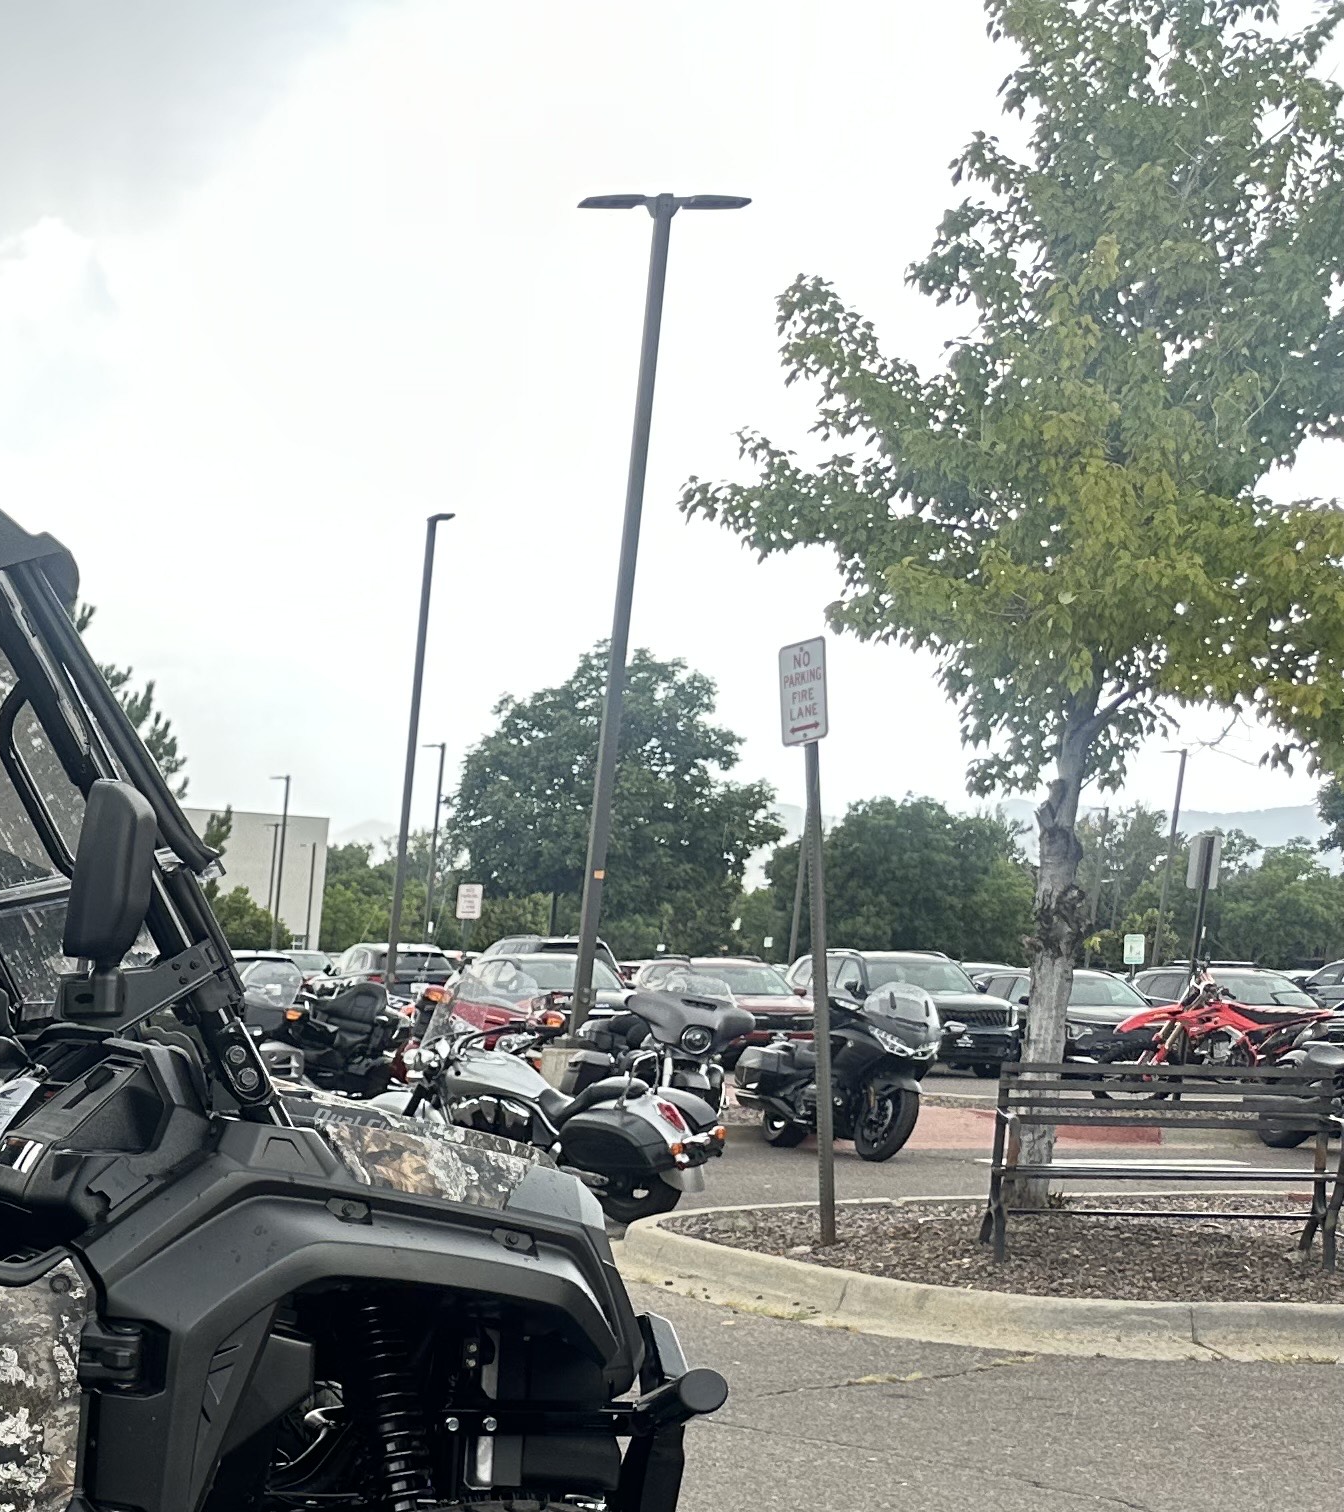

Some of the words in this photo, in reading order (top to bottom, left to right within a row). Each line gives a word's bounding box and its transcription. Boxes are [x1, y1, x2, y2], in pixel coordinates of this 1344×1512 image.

[793, 651, 810, 669] NO
[783, 667, 821, 689] PARKING
[792, 687, 814, 704] FIRE
[789, 703, 818, 721] LANE
